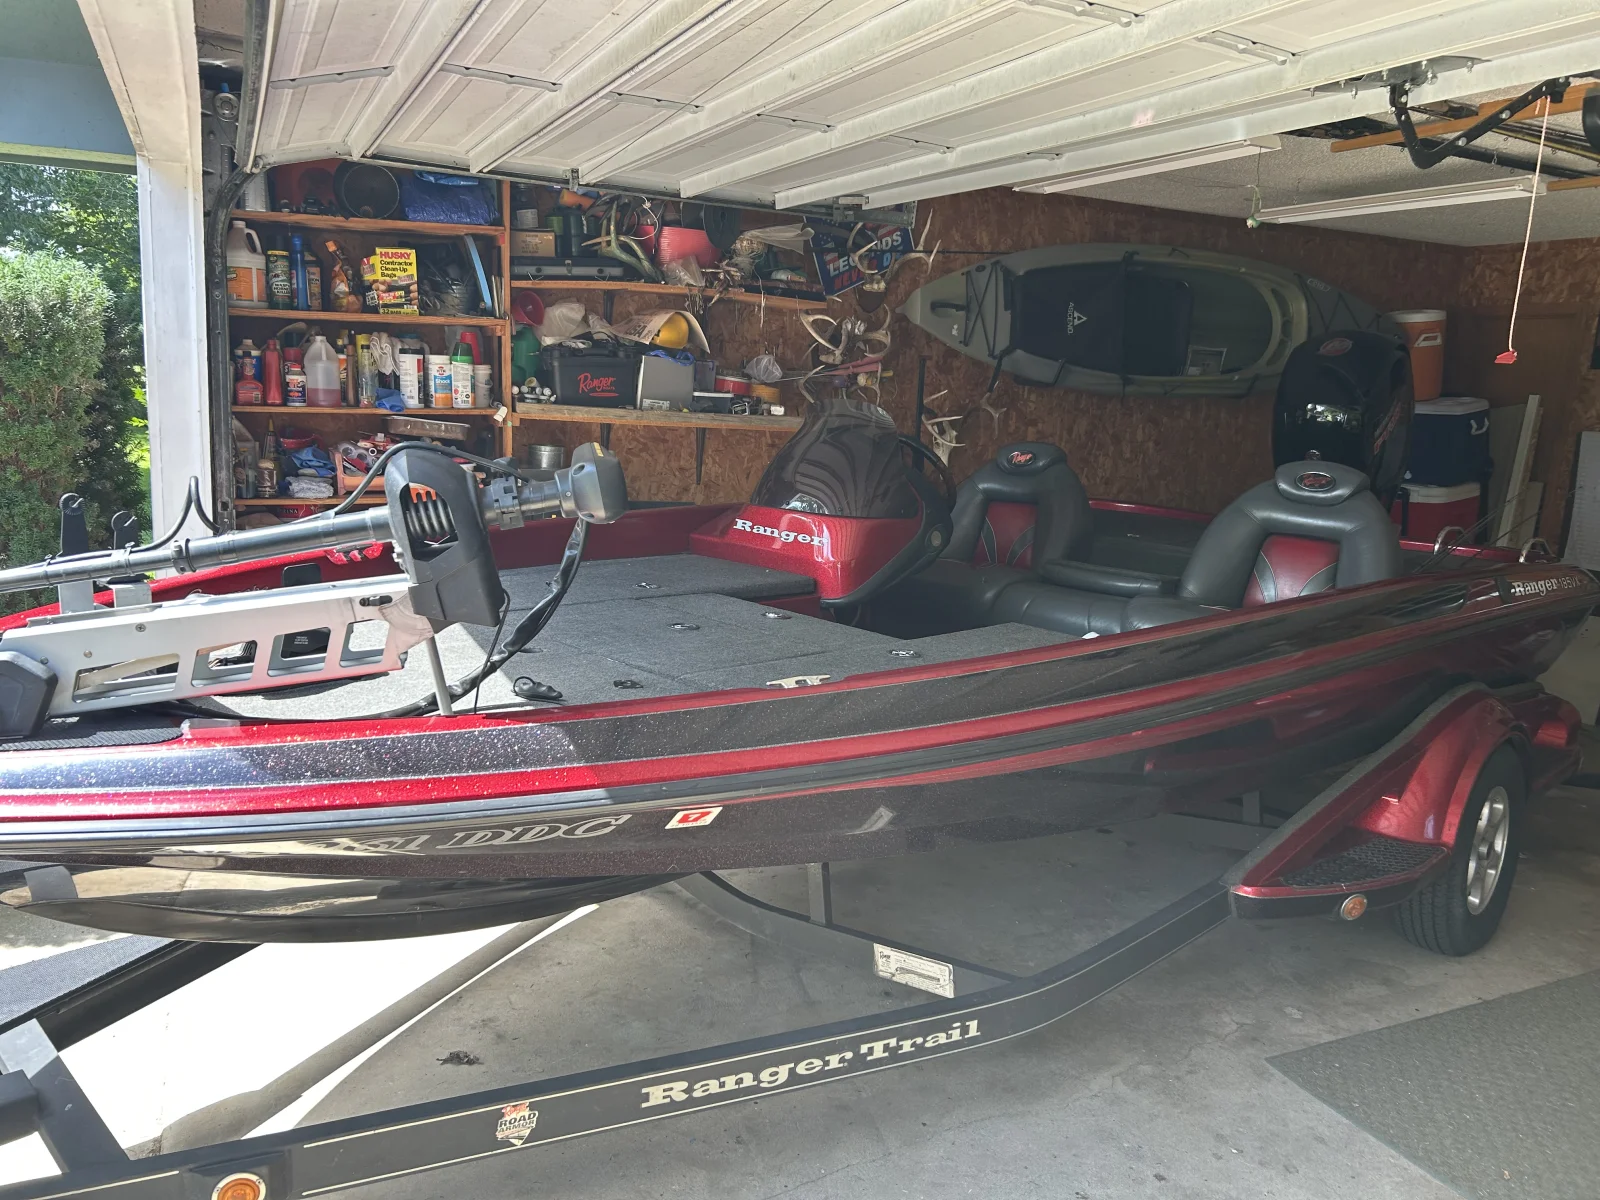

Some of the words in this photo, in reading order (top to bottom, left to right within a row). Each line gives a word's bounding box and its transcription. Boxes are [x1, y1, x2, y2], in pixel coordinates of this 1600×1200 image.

[379, 251, 412, 260] HUSKY
[577, 372, 616, 394] Ranger
[733, 518, 828, 547] Ranger
[1511, 578, 1558, 596] Ranger
[436, 814, 632, 849] DDC
[640, 1050, 853, 1108] Ranger
[860, 1020, 980, 1061] Trail
[498, 1120, 535, 1133] ARMOR
[499, 1112, 537, 1128] ROAD
